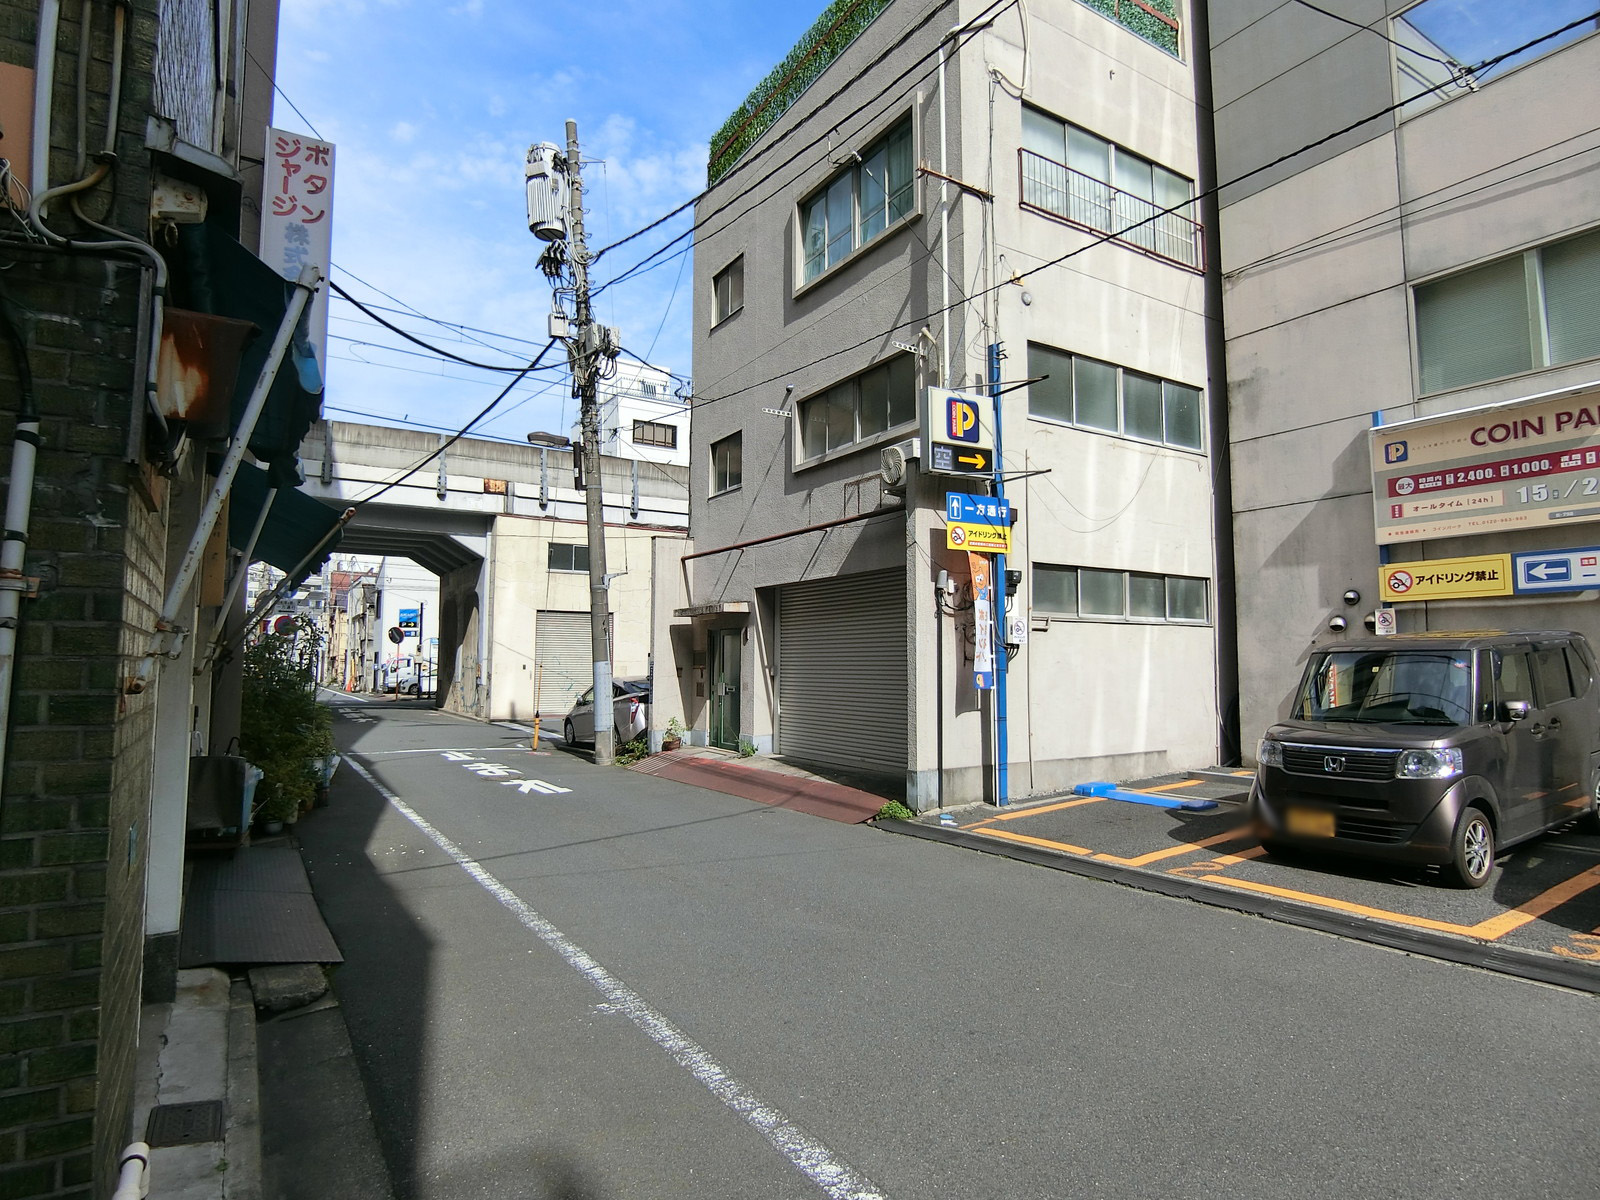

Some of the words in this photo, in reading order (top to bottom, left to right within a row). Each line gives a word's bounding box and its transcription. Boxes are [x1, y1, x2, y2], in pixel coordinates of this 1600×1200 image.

[272, 136, 301, 217] ジャージ
[302, 145, 330, 224] ボタン
[1469, 416, 1545, 447] COIN
[1555, 405, 1600, 432] PA
[965, 503, 1007, 518] 一方通行
[1412, 499, 1463, 513] オールタイム
[968, 530, 1007, 541] アイドリング禁止
[1415, 569, 1499, 586] アイドリング禁止
[440, 750, 574, 795] 止まれ
